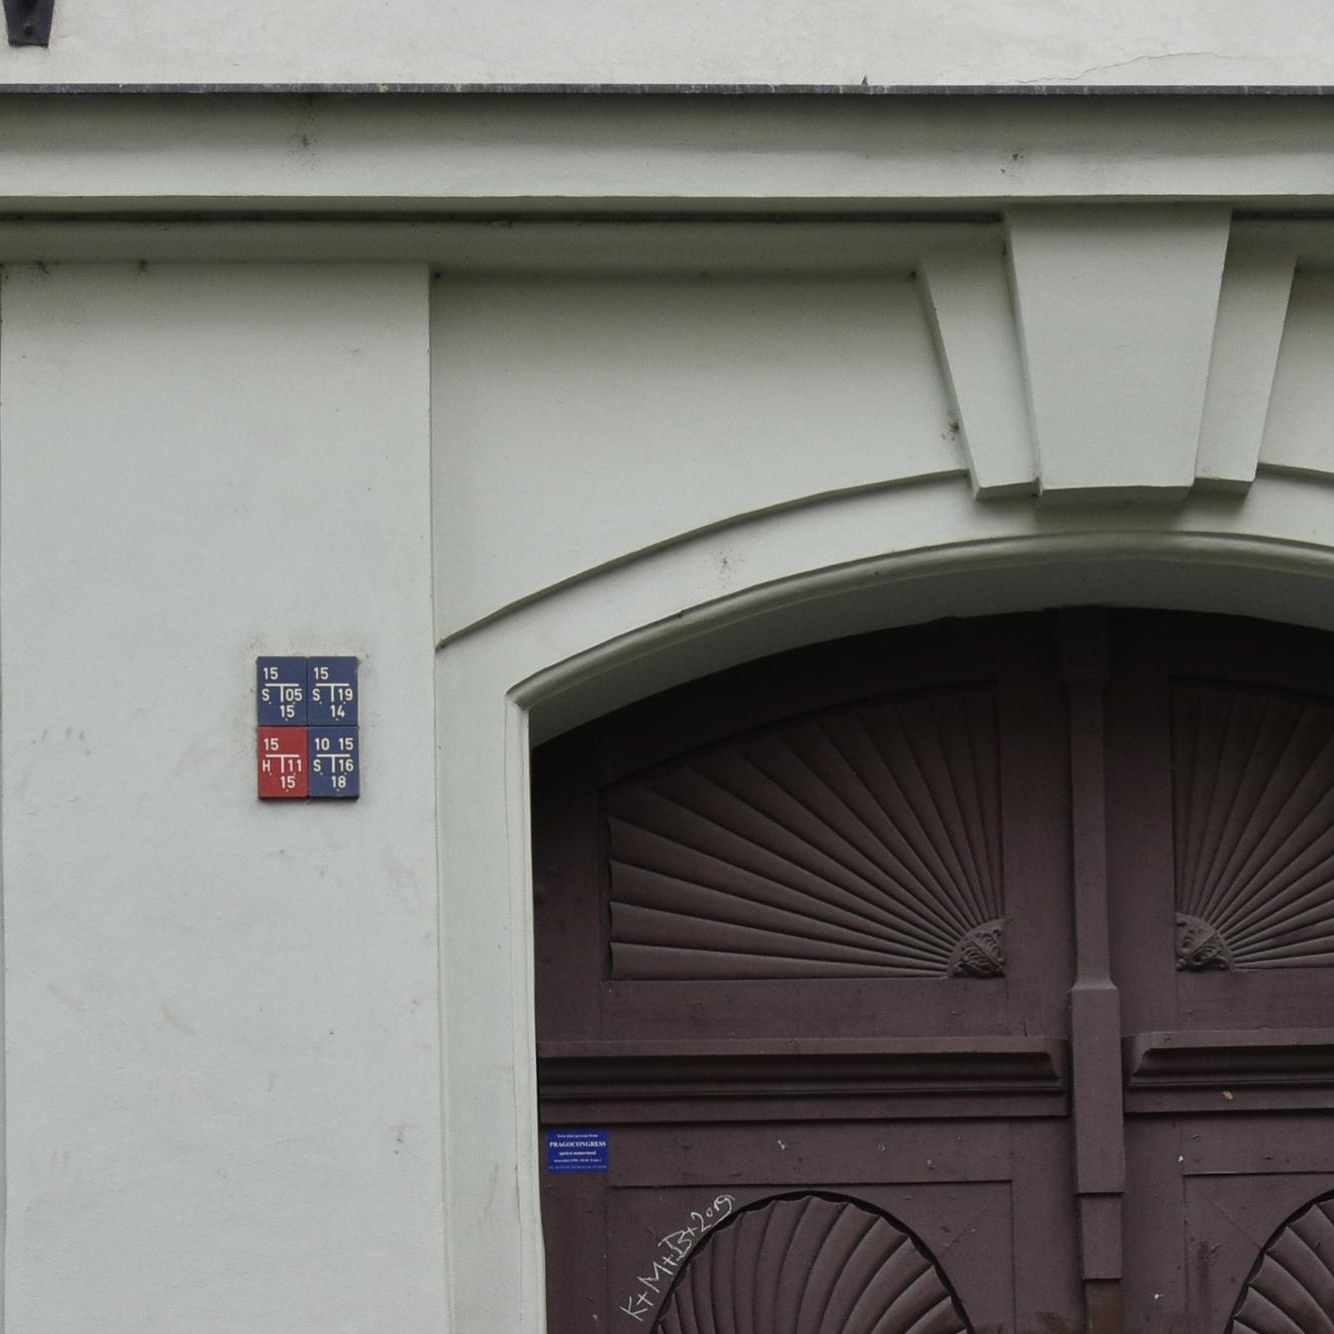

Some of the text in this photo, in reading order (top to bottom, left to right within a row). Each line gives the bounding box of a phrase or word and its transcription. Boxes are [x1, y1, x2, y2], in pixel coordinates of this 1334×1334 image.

[263, 666, 279, 680] 15
[313, 666, 329, 680] 15
[263, 737, 279, 751] 15
[314, 737, 354, 751] 10 15
